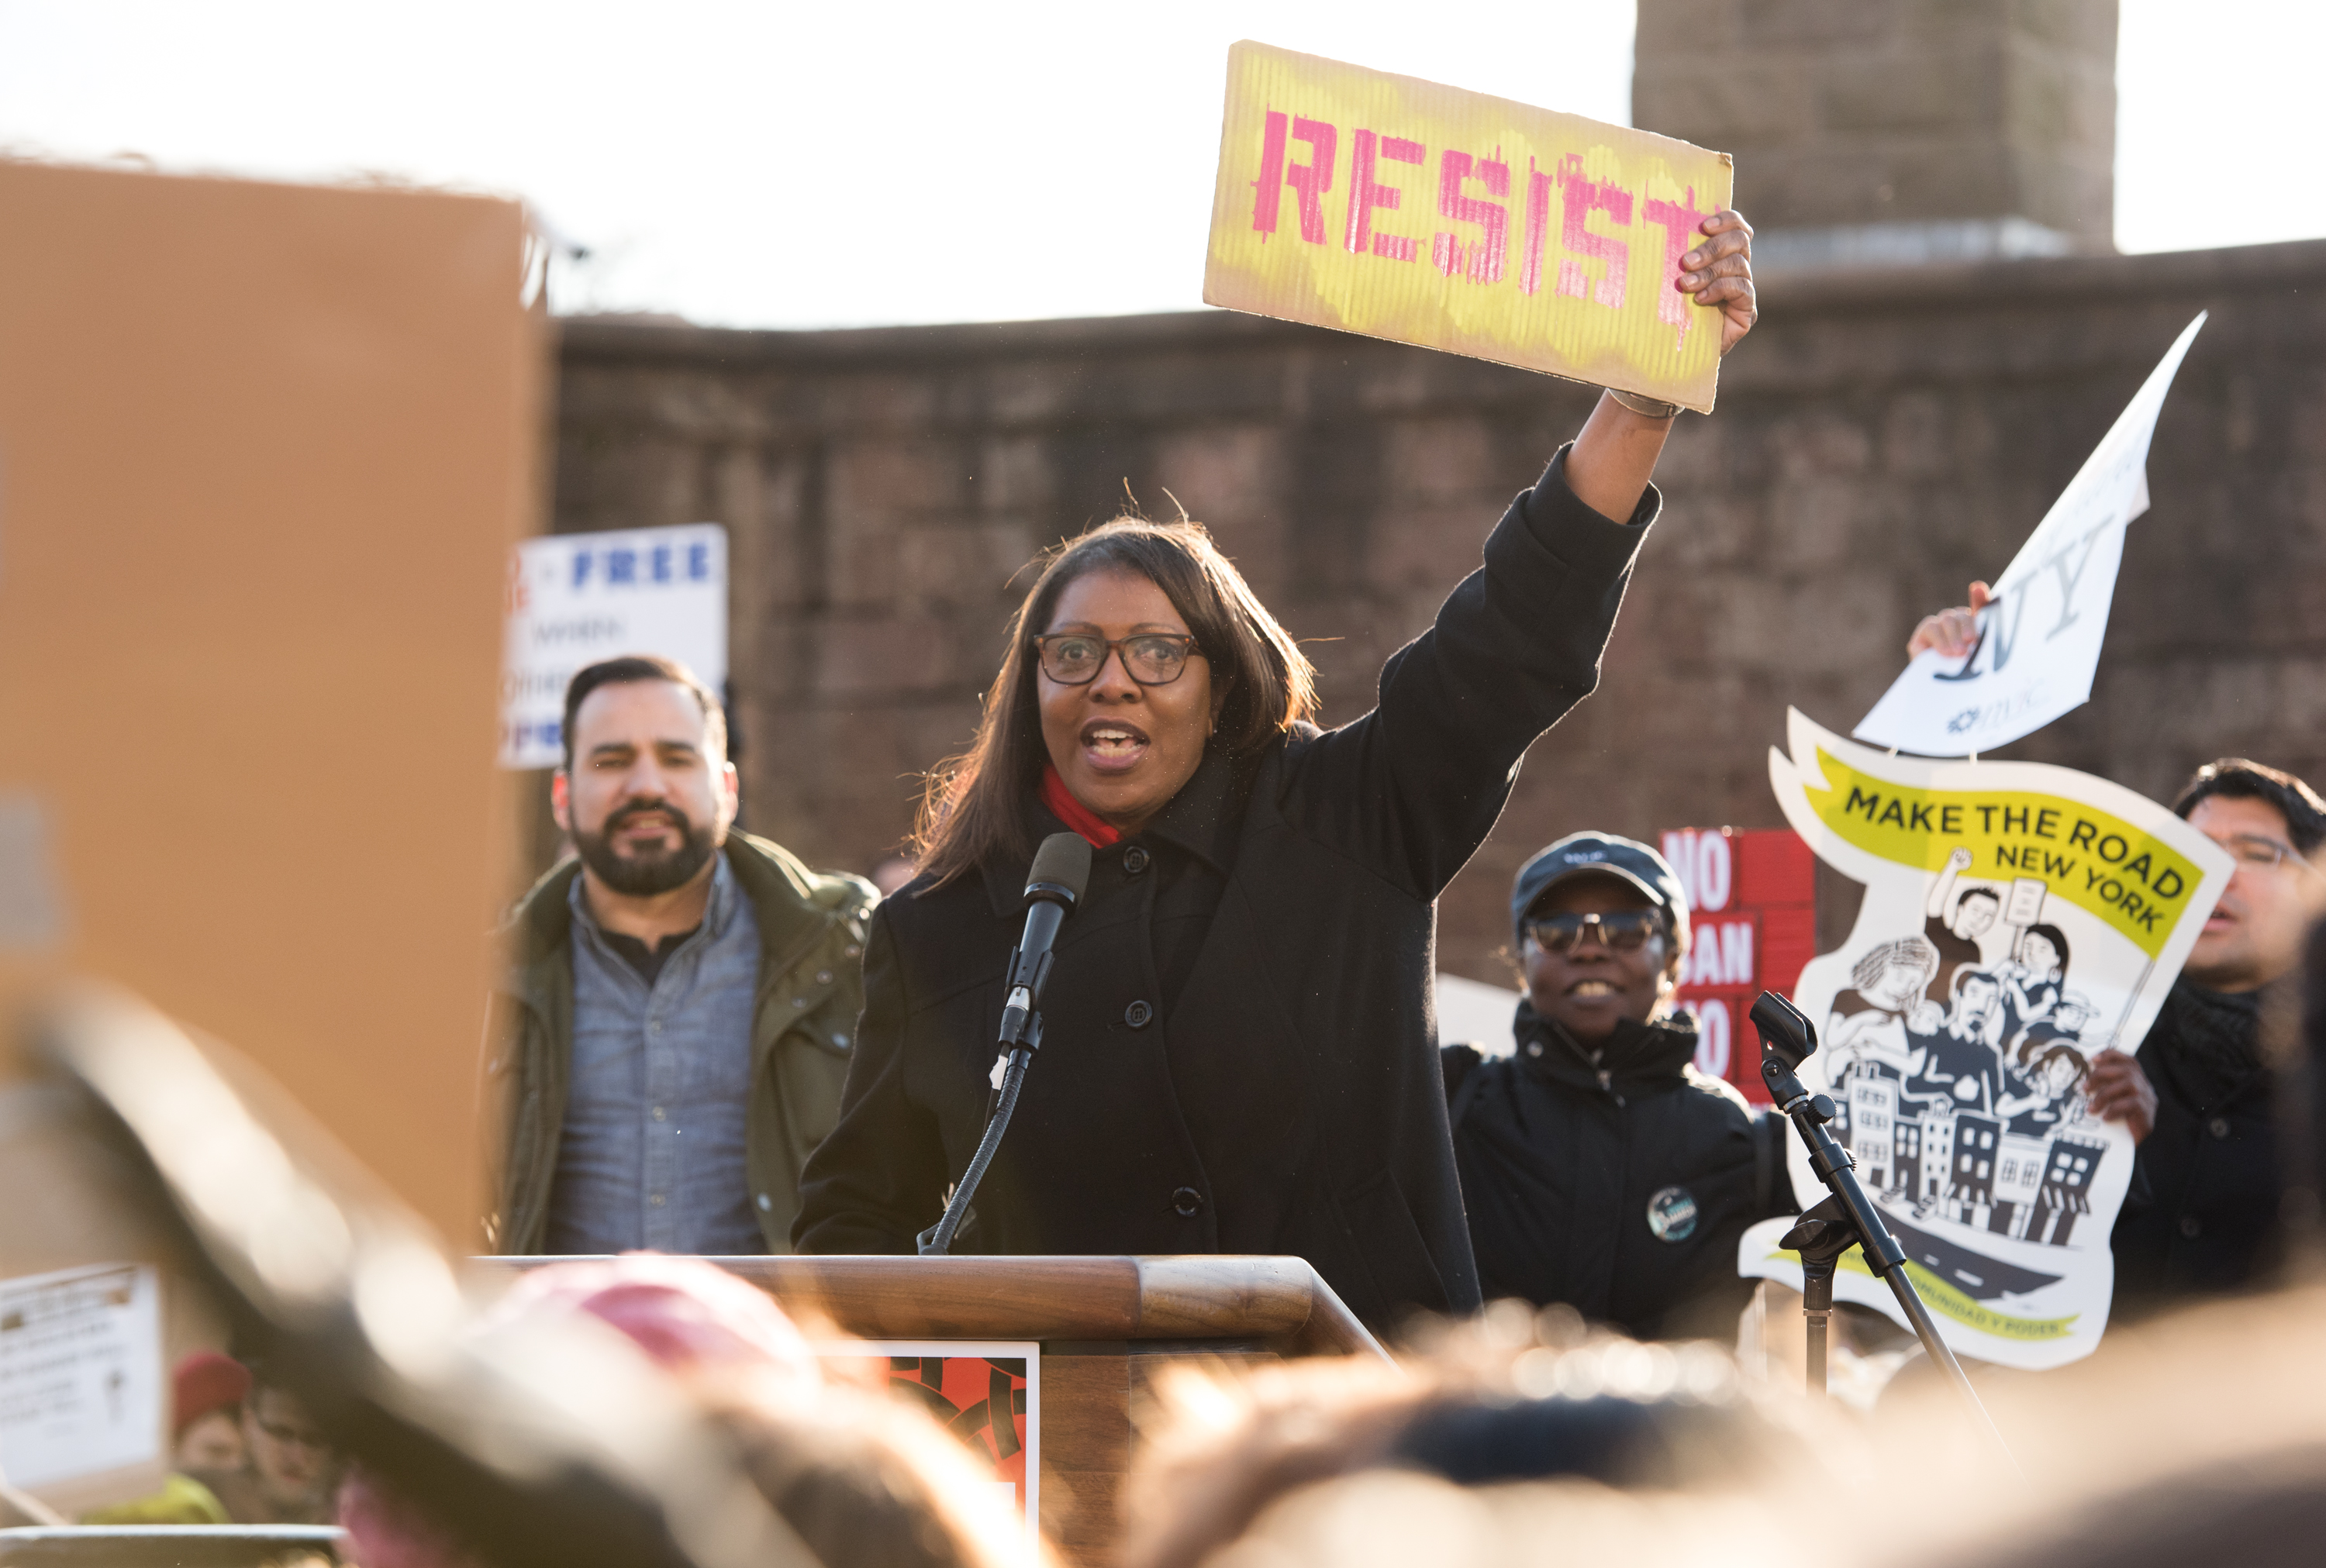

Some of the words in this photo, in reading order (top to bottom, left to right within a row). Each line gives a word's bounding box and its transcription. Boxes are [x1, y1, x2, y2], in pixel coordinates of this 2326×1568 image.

[1251, 103, 1720, 347] RESIST
[1934, 513, 2115, 681] NY
[1663, 829, 1731, 912] NO
[1845, 786, 1964, 834] MAKE
[1976, 803, 2061, 839] THE
[2068, 817, 2184, 900] ROAD
[1996, 843, 2077, 880] NEW
[2085, 866, 2166, 935] YORK
[1907, 1270, 1987, 1326] OMUNIDAD
